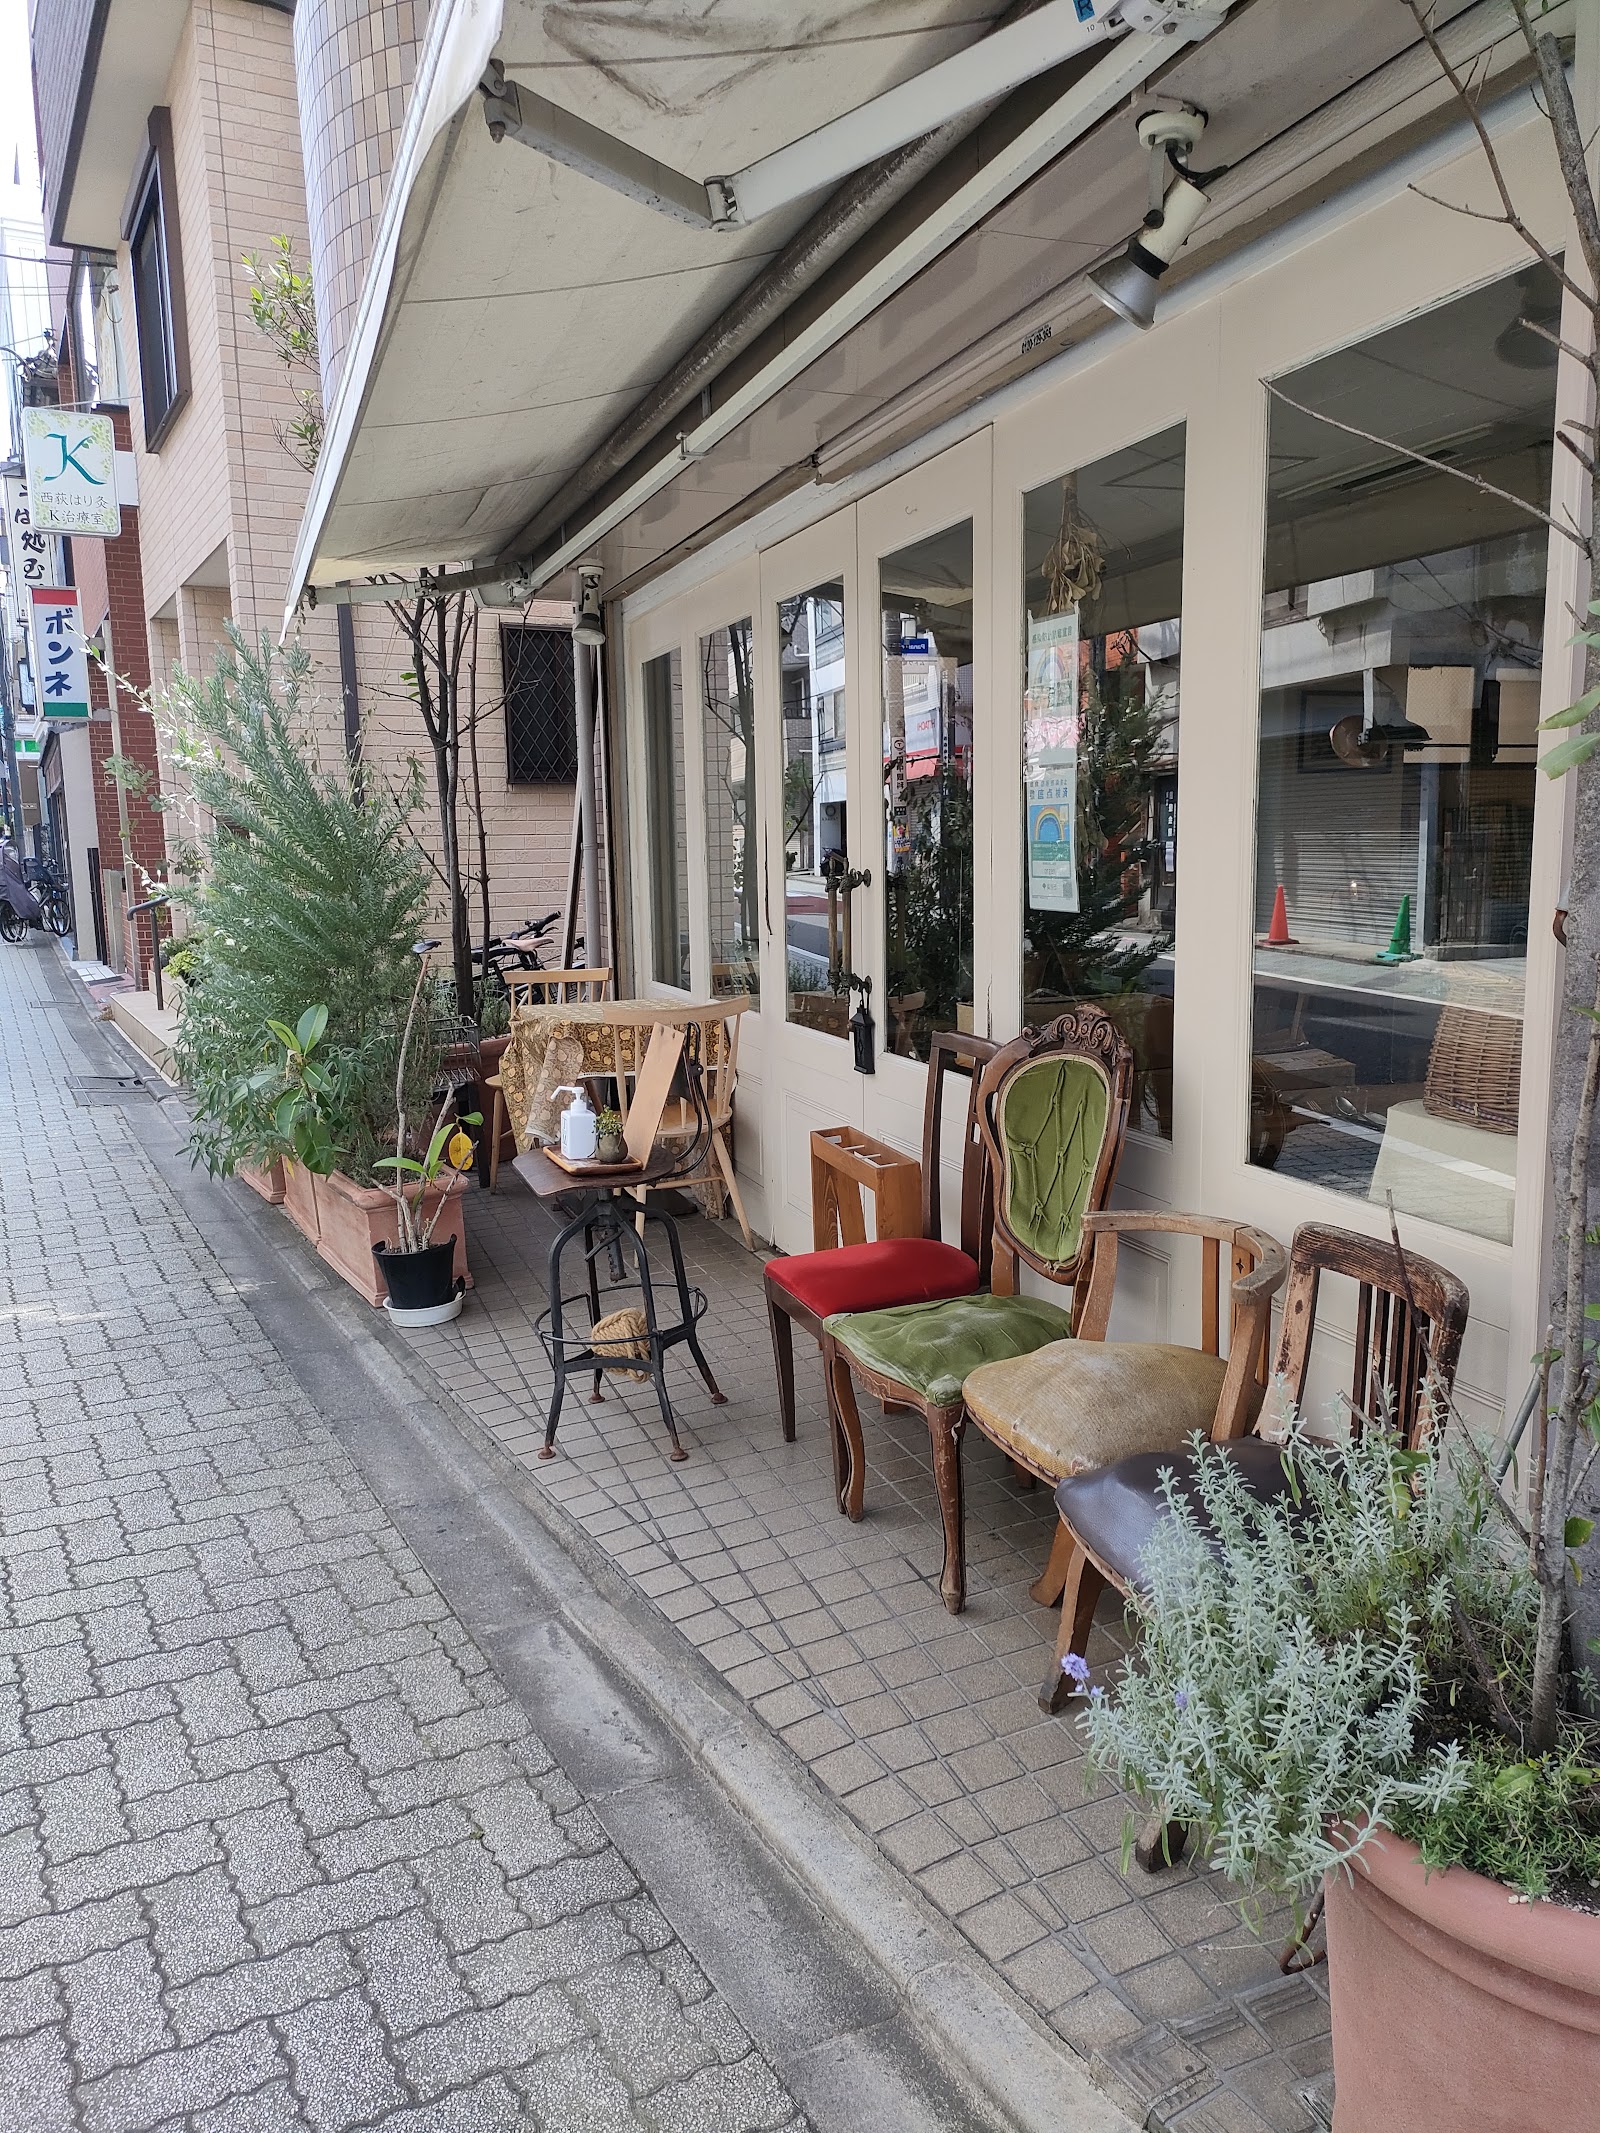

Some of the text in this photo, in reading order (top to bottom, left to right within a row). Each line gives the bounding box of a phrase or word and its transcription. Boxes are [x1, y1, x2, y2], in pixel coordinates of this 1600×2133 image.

[43, 432, 107, 486] K
[40, 491, 109, 510] 西荻はり灸
[49, 508, 105, 526] K治療室
[44, 606, 75, 697] ボンネ
